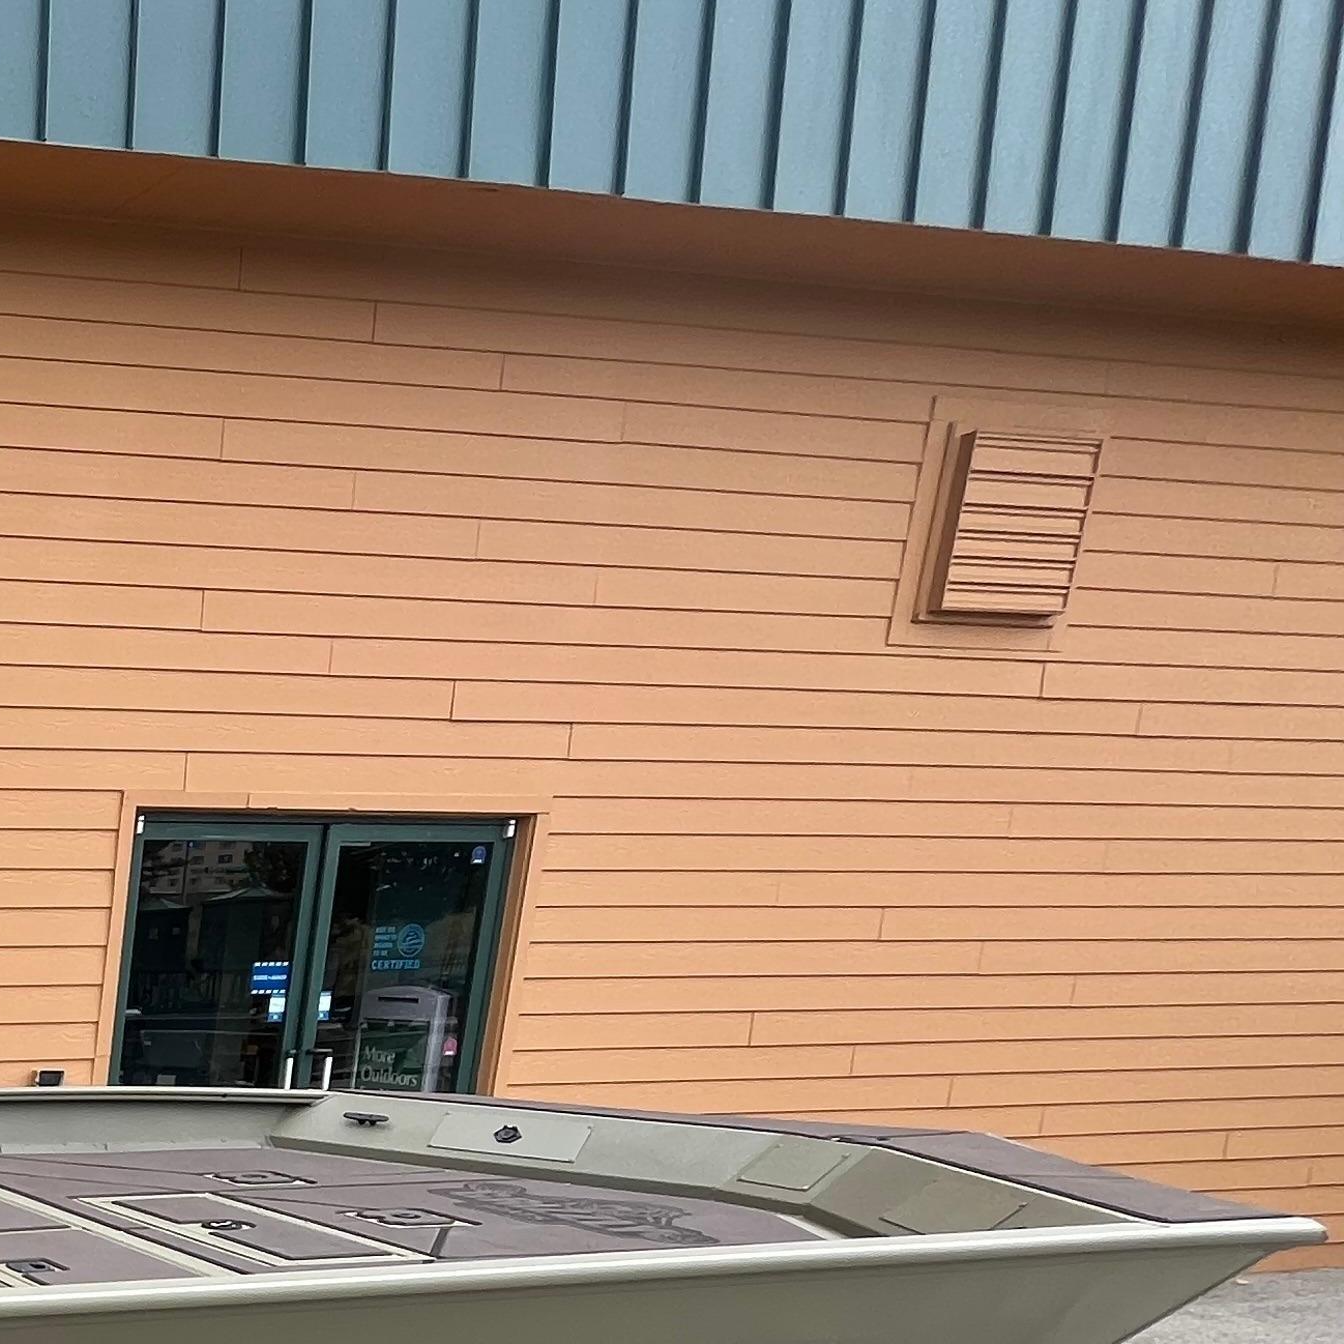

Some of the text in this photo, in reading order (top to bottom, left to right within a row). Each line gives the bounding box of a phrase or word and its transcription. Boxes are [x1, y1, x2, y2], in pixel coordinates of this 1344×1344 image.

[371, 959, 420, 970] CERTIFIED
[364, 1045, 396, 1063] More
[361, 1065, 418, 1087] Outdoors
